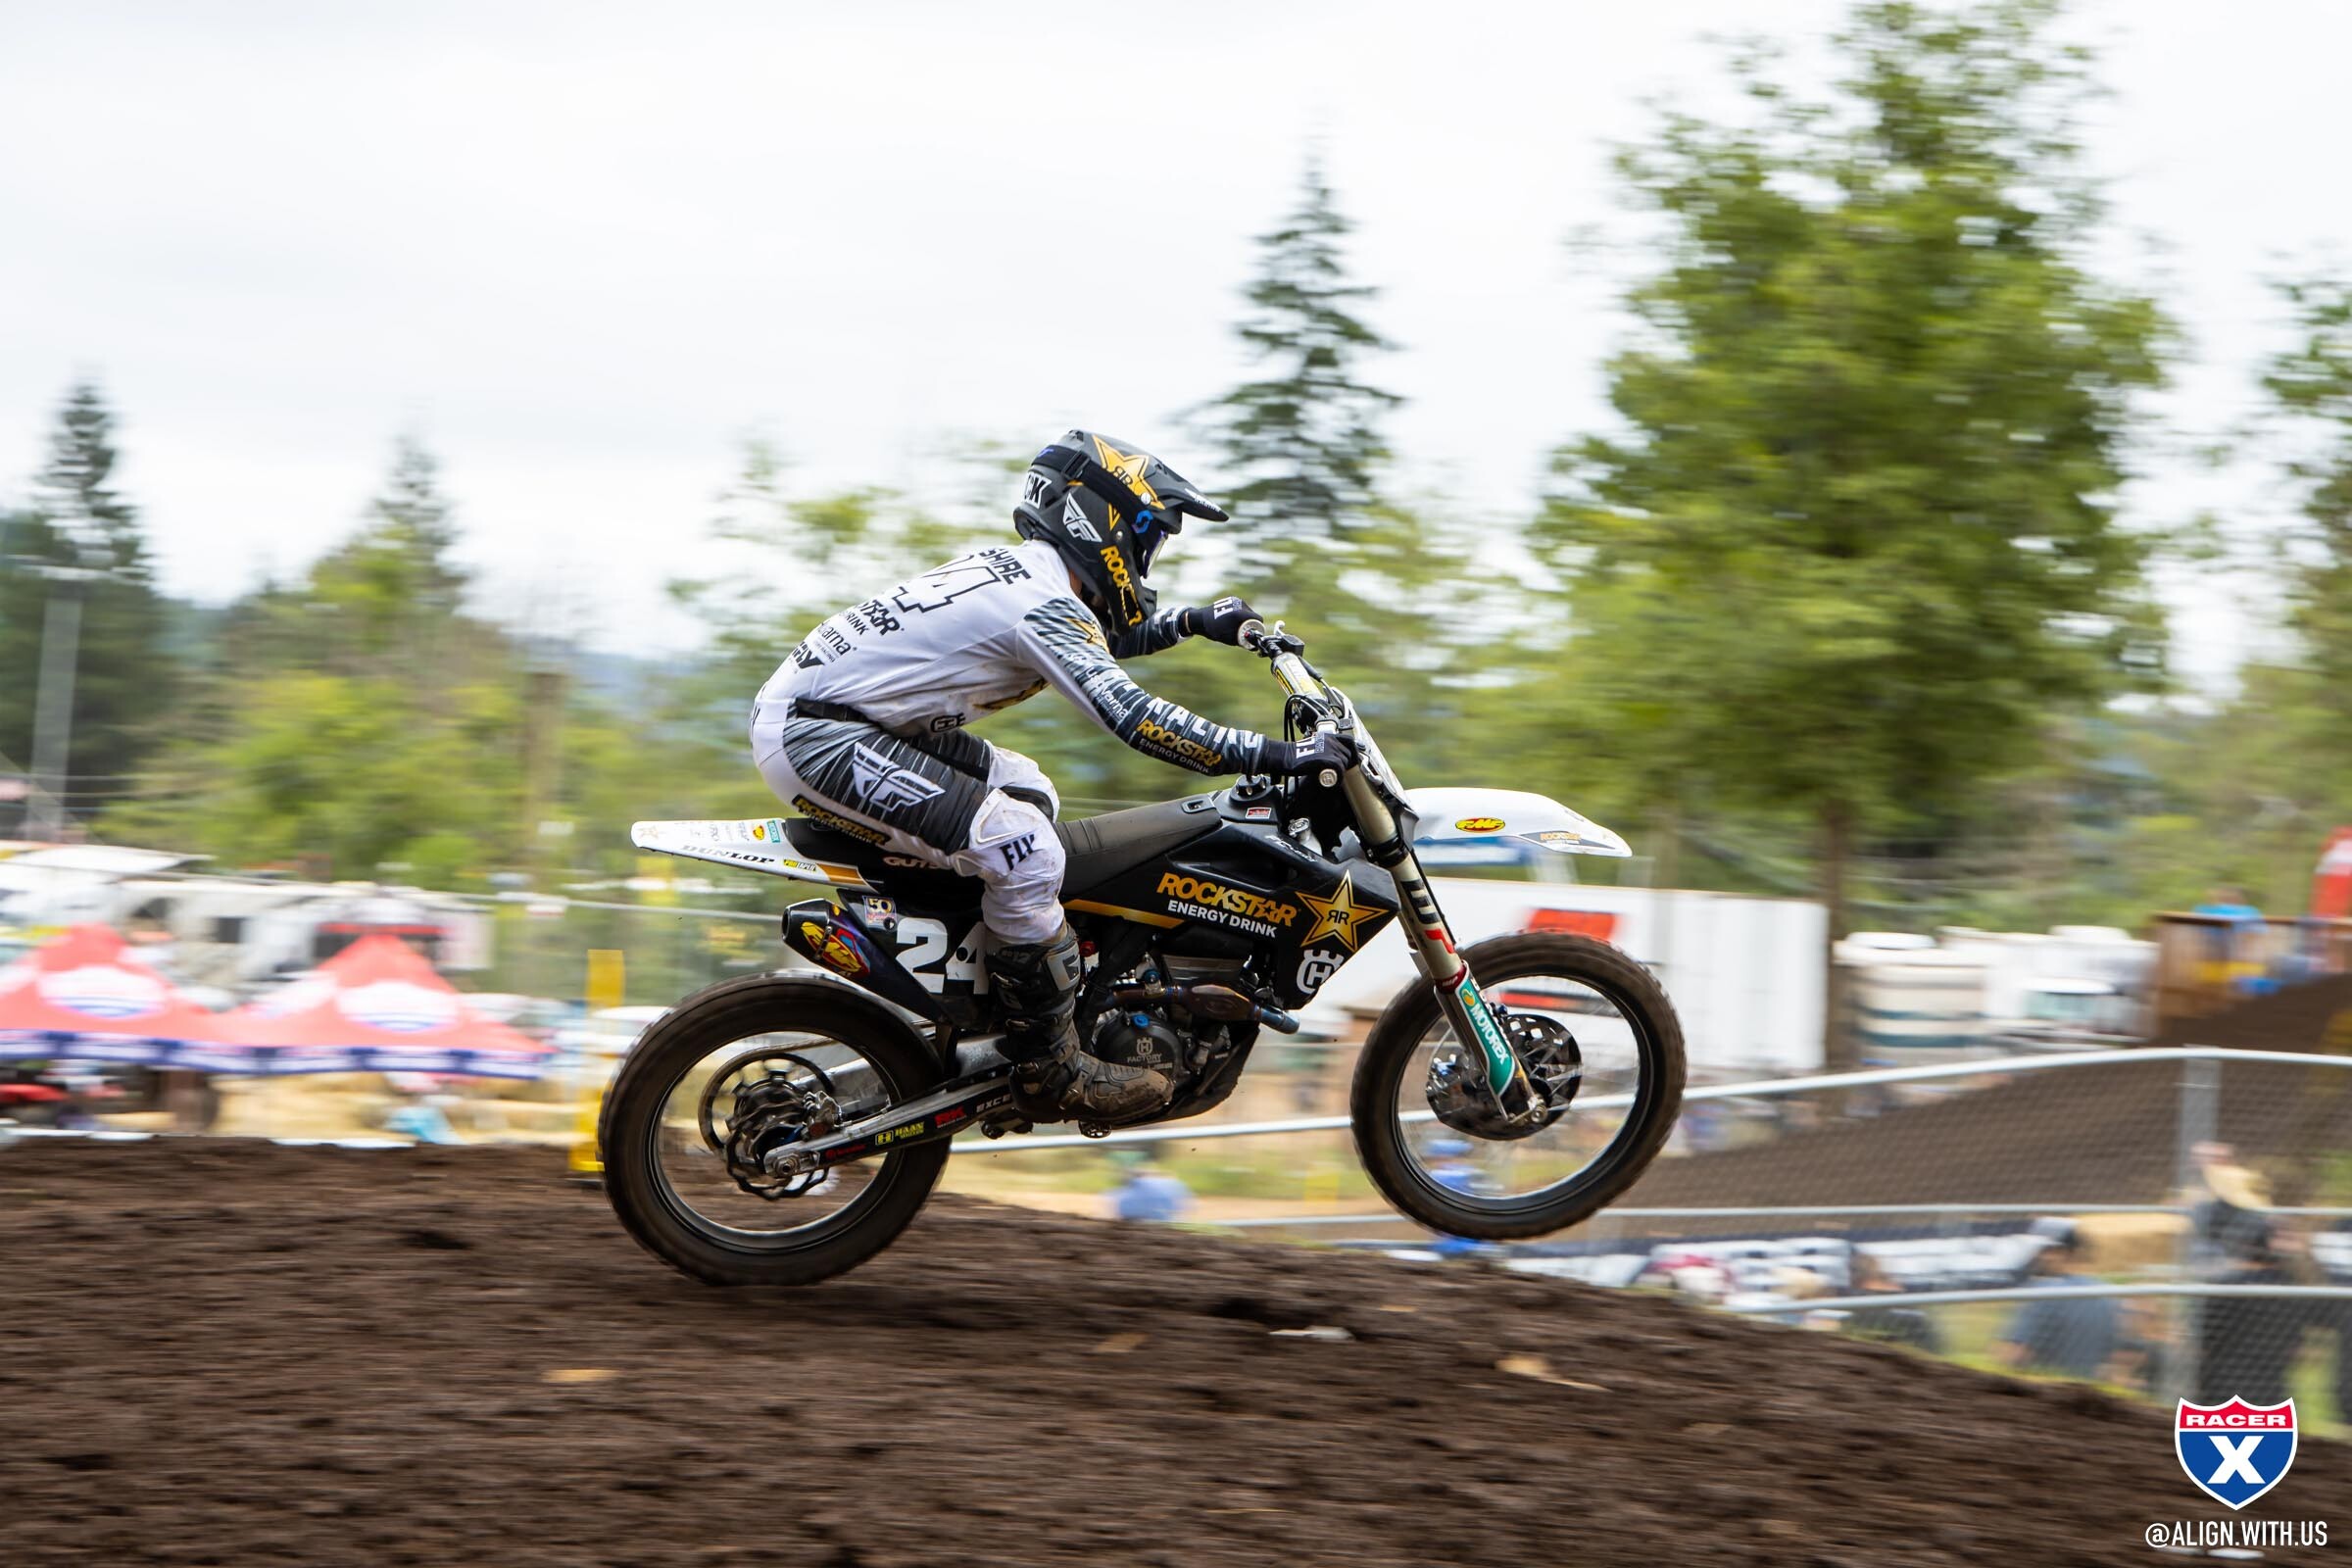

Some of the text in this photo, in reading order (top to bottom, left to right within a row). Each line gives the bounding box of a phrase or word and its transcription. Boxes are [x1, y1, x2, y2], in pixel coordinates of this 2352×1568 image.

[818, 621, 852, 656] arna
[843, 610, 870, 636] RINK
[1136, 718, 1222, 766] ROCKSTAR
[1139, 738, 1210, 774] ENERGY DRINK
[680, 844, 775, 863] DUNLOP
[999, 834, 1035, 871] FLY
[1156, 872, 1298, 927] ROCKSTAR
[1167, 900, 1277, 938] ENERGY DRINK
[896, 916, 990, 996] 24
[1470, 1004, 1510, 1065] MOTOREX
[1127, 1053, 1162, 1063] FACTORY
